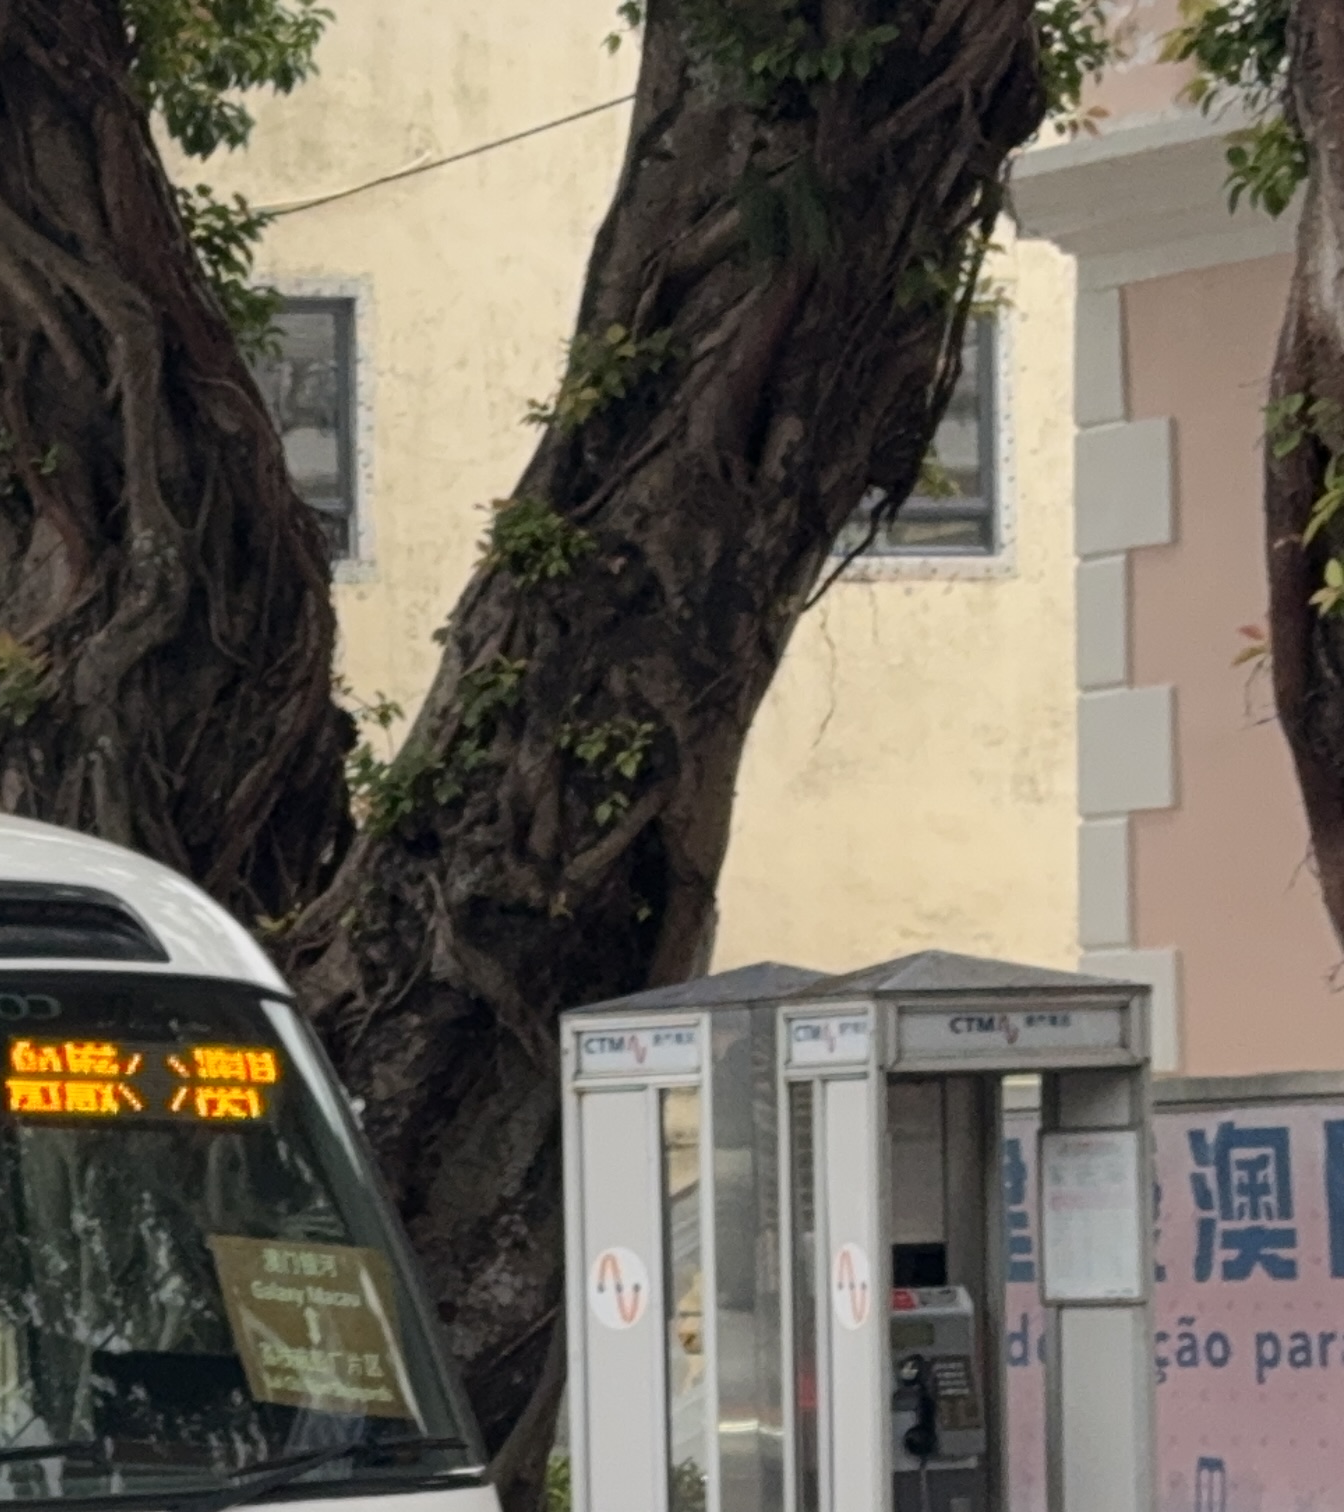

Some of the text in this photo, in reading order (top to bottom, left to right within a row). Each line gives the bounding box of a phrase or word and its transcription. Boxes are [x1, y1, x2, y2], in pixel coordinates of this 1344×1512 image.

[794, 1024, 821, 1043] CTM
[949, 1015, 995, 1035] CTM
[585, 1036, 625, 1055] CTM
[1188, 1120, 1344, 1284] 澳
[1255, 1330, 1344, 1385] par
